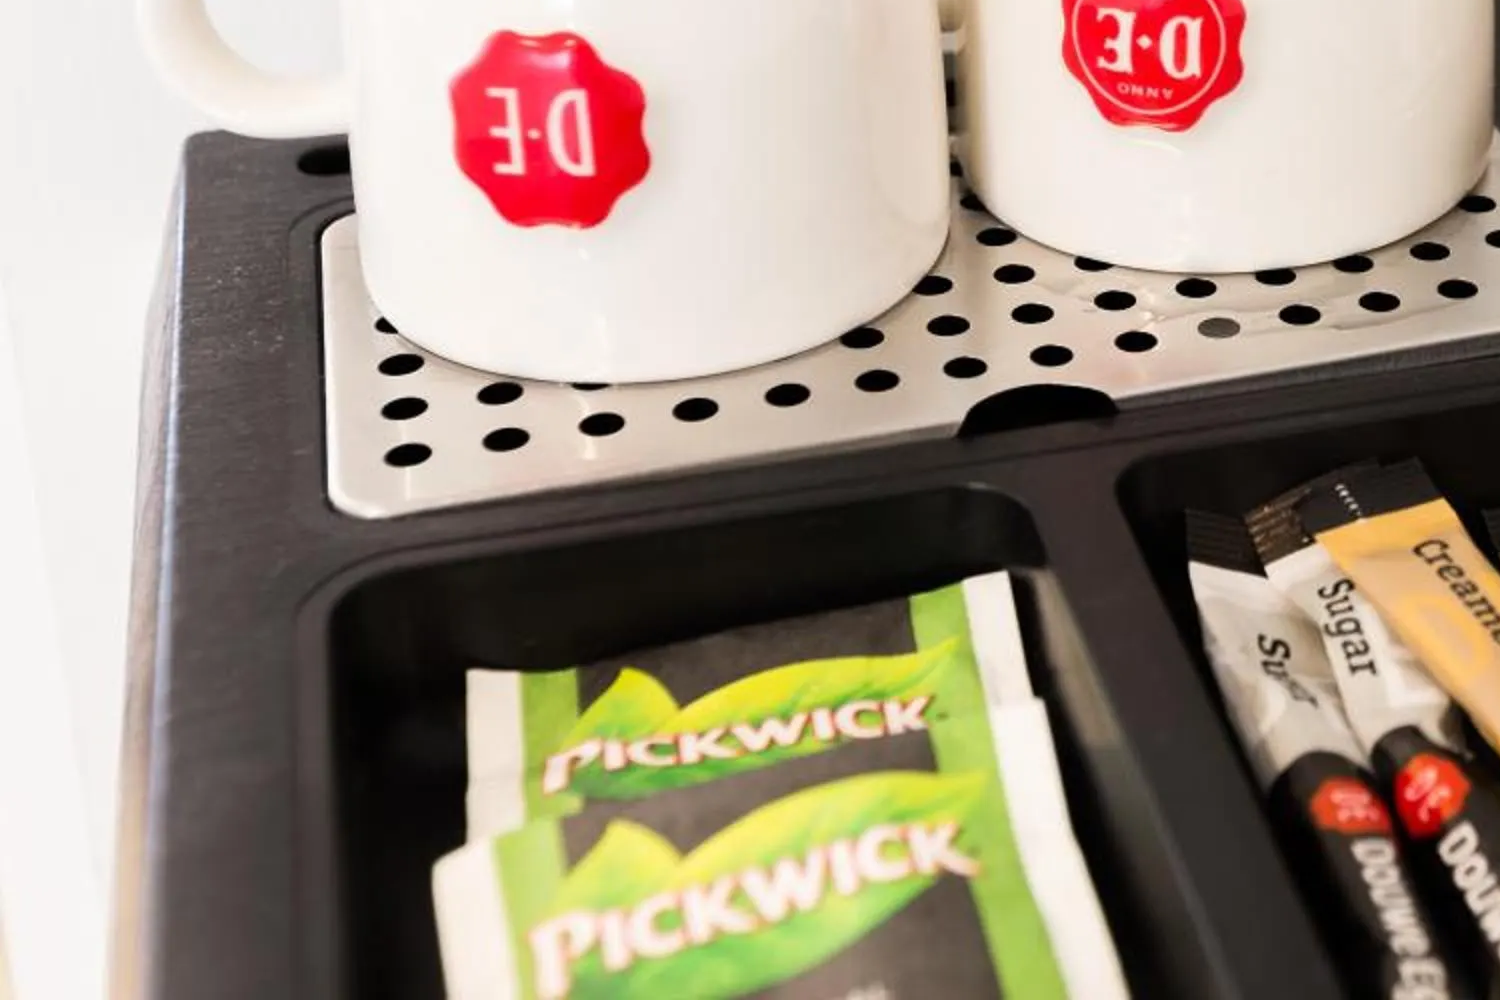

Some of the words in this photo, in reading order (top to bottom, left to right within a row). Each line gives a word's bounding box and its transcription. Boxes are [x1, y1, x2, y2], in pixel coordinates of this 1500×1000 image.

[1116, 81, 1174, 101] ANNO
[1318, 579, 1380, 678] Sugar
[543, 694, 935, 794] PICKWICK
[527, 822, 981, 1000] PICKWICK
[1351, 837, 1430, 955] Douwe
